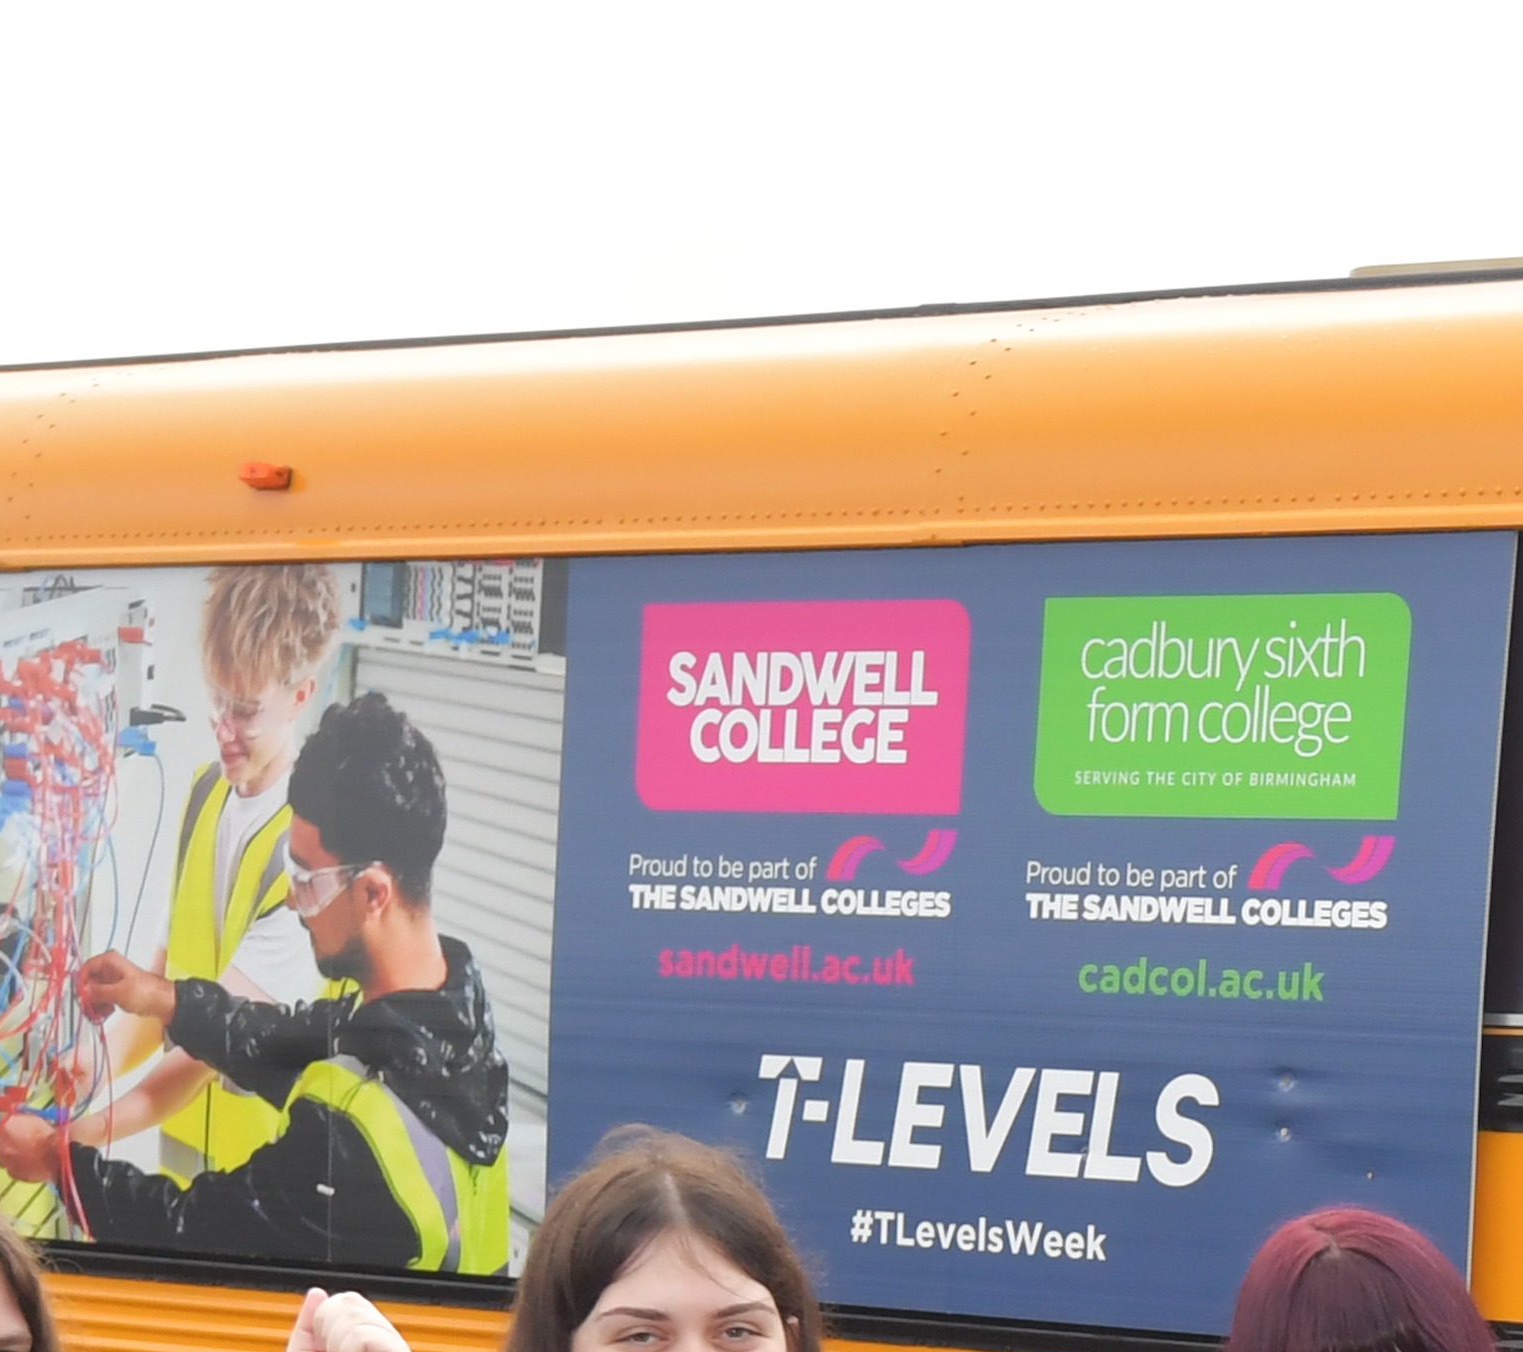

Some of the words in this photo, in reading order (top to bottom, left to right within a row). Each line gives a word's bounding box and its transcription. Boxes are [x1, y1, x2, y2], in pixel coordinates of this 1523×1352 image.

[1081, 620, 1260, 692] cadbury
[1264, 618, 1366, 678] sixth
[667, 650, 938, 707] SANDWELL
[689, 708, 909, 765] COLLEGE
[1086, 685, 1189, 743] form
[1198, 684, 1352, 758] college
[1074, 770, 1140, 786] SERVING
[1146, 771, 1175, 786] THE
[1181, 772, 1217, 787] CITY
[1222, 772, 1243, 787] OF
[1249, 772, 1357, 788] BIRMINGHAM
[629, 854, 687, 877] Proud
[693, 857, 709, 878] to
[718, 856, 744, 879] be
[749, 858, 789, 883] part
[796, 856, 817, 880] of
[1026, 860, 1091, 886] Proud
[1097, 863, 1119, 887] to
[1127, 862, 1154, 889] be
[1160, 865, 1206, 892] part
[1213, 864, 1238, 890] of
[628, 884, 677, 909] THE
[679, 885, 817, 914] SANDWELL
[820, 889, 951, 918] COLLEGES
[1025, 893, 1079, 920] THE
[1082, 894, 1236, 925] SANDWELL
[1241, 898, 1388, 929] COLLEGES
[658, 943, 915, 986] sandwell.ac.uk
[1078, 956, 1325, 1002] cadcol.ac.uk
[758, 1053, 1220, 1188] T-LEVELS
[850, 1208, 1108, 1261] #TLevelsWeek
